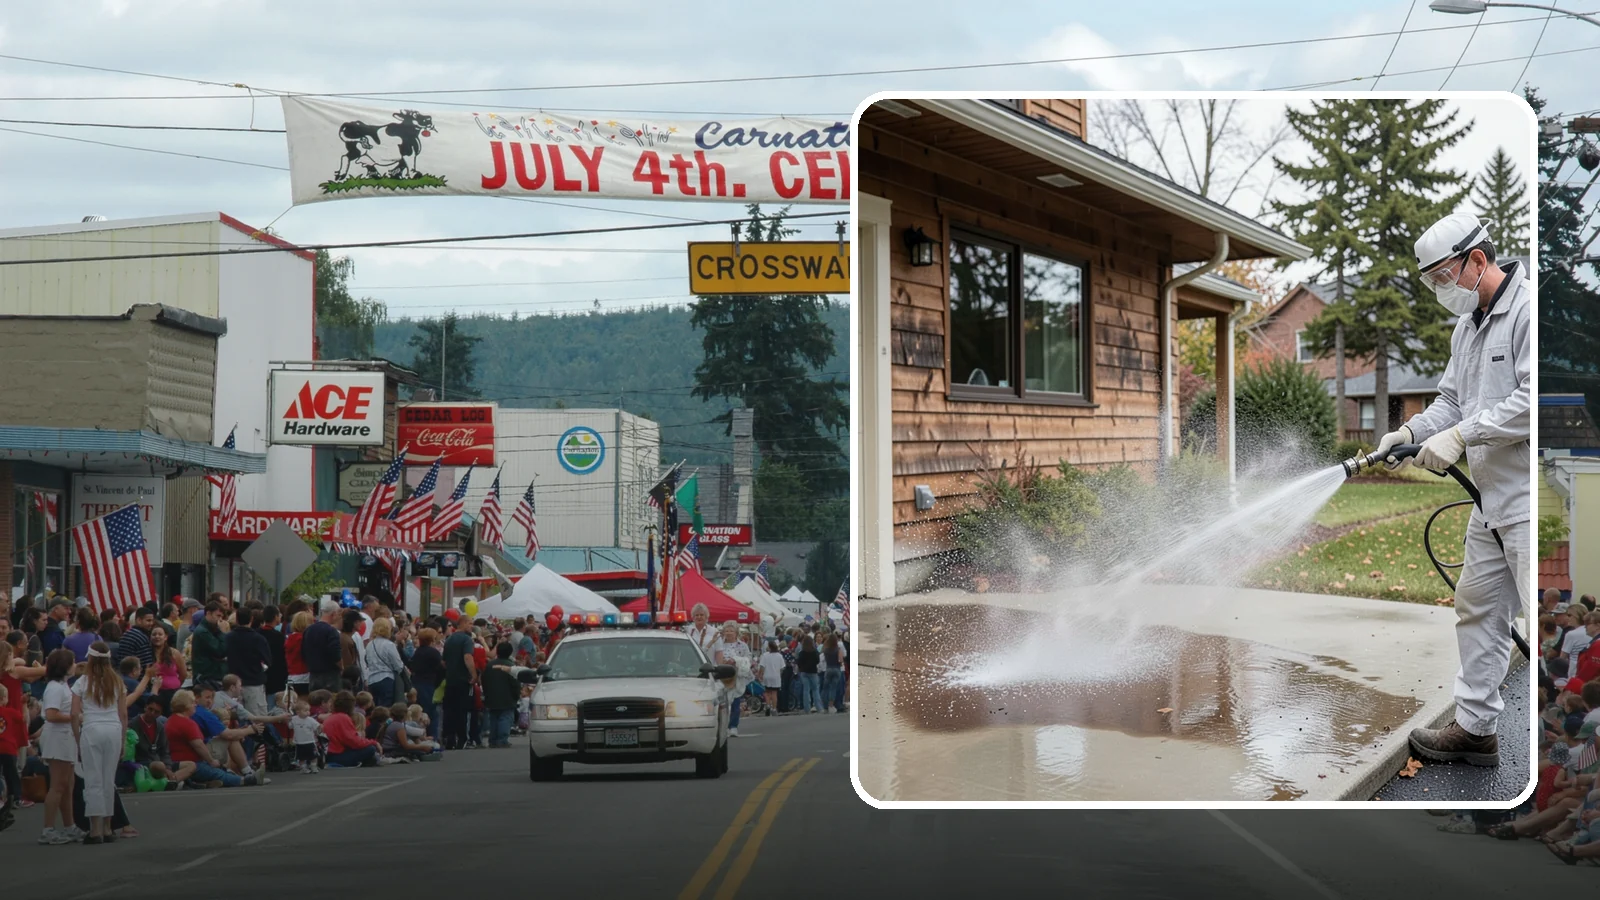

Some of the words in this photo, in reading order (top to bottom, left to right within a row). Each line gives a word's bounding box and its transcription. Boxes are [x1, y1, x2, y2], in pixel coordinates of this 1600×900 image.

[481, 141, 604, 192] JULY
[632, 151, 746, 197] 4th.
[697, 255, 850, 280] CROSSWA
[283, 380, 374, 420] ACE
[406, 409, 452, 422] CEDAR
[461, 410, 485, 422] LOG
[283, 421, 371, 436] Hardware
[416, 428, 477, 447] Coca-Cola
[353, 467, 386, 480] Simpl
[95, 485, 124, 495] Vincent
[126, 486, 136, 495] de
[137, 486, 155, 495] Paul
[213, 516, 330, 535] HARDARE
[688, 526, 741, 535] CRNATION
[699, 535, 730, 543] GLASS
